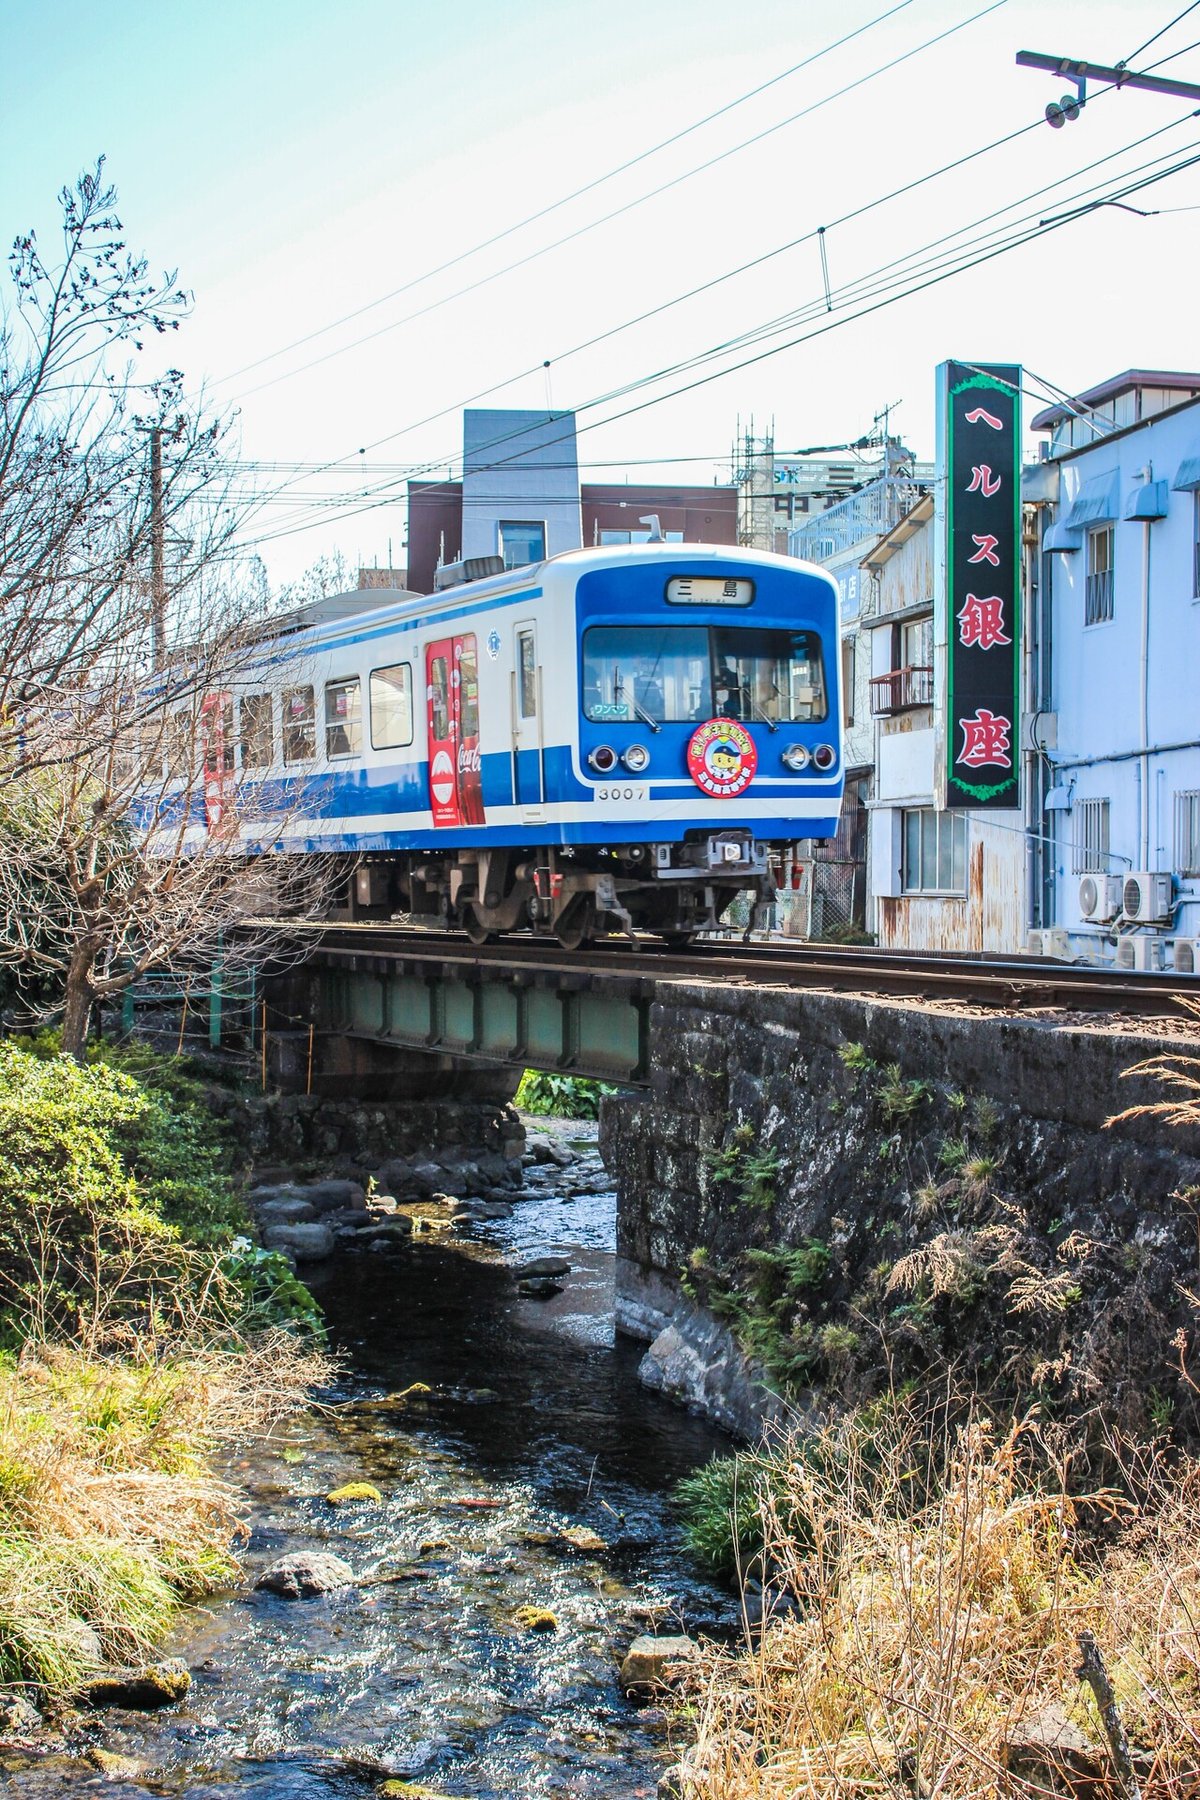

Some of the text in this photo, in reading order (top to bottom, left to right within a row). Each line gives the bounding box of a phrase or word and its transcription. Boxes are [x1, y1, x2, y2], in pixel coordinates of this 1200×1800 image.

[677, 579, 737, 597] 三島
[957, 407, 1012, 767] ヘルス銀座
[594, 704, 627, 714] ワンマン
[599, 788, 644, 801] 3007
